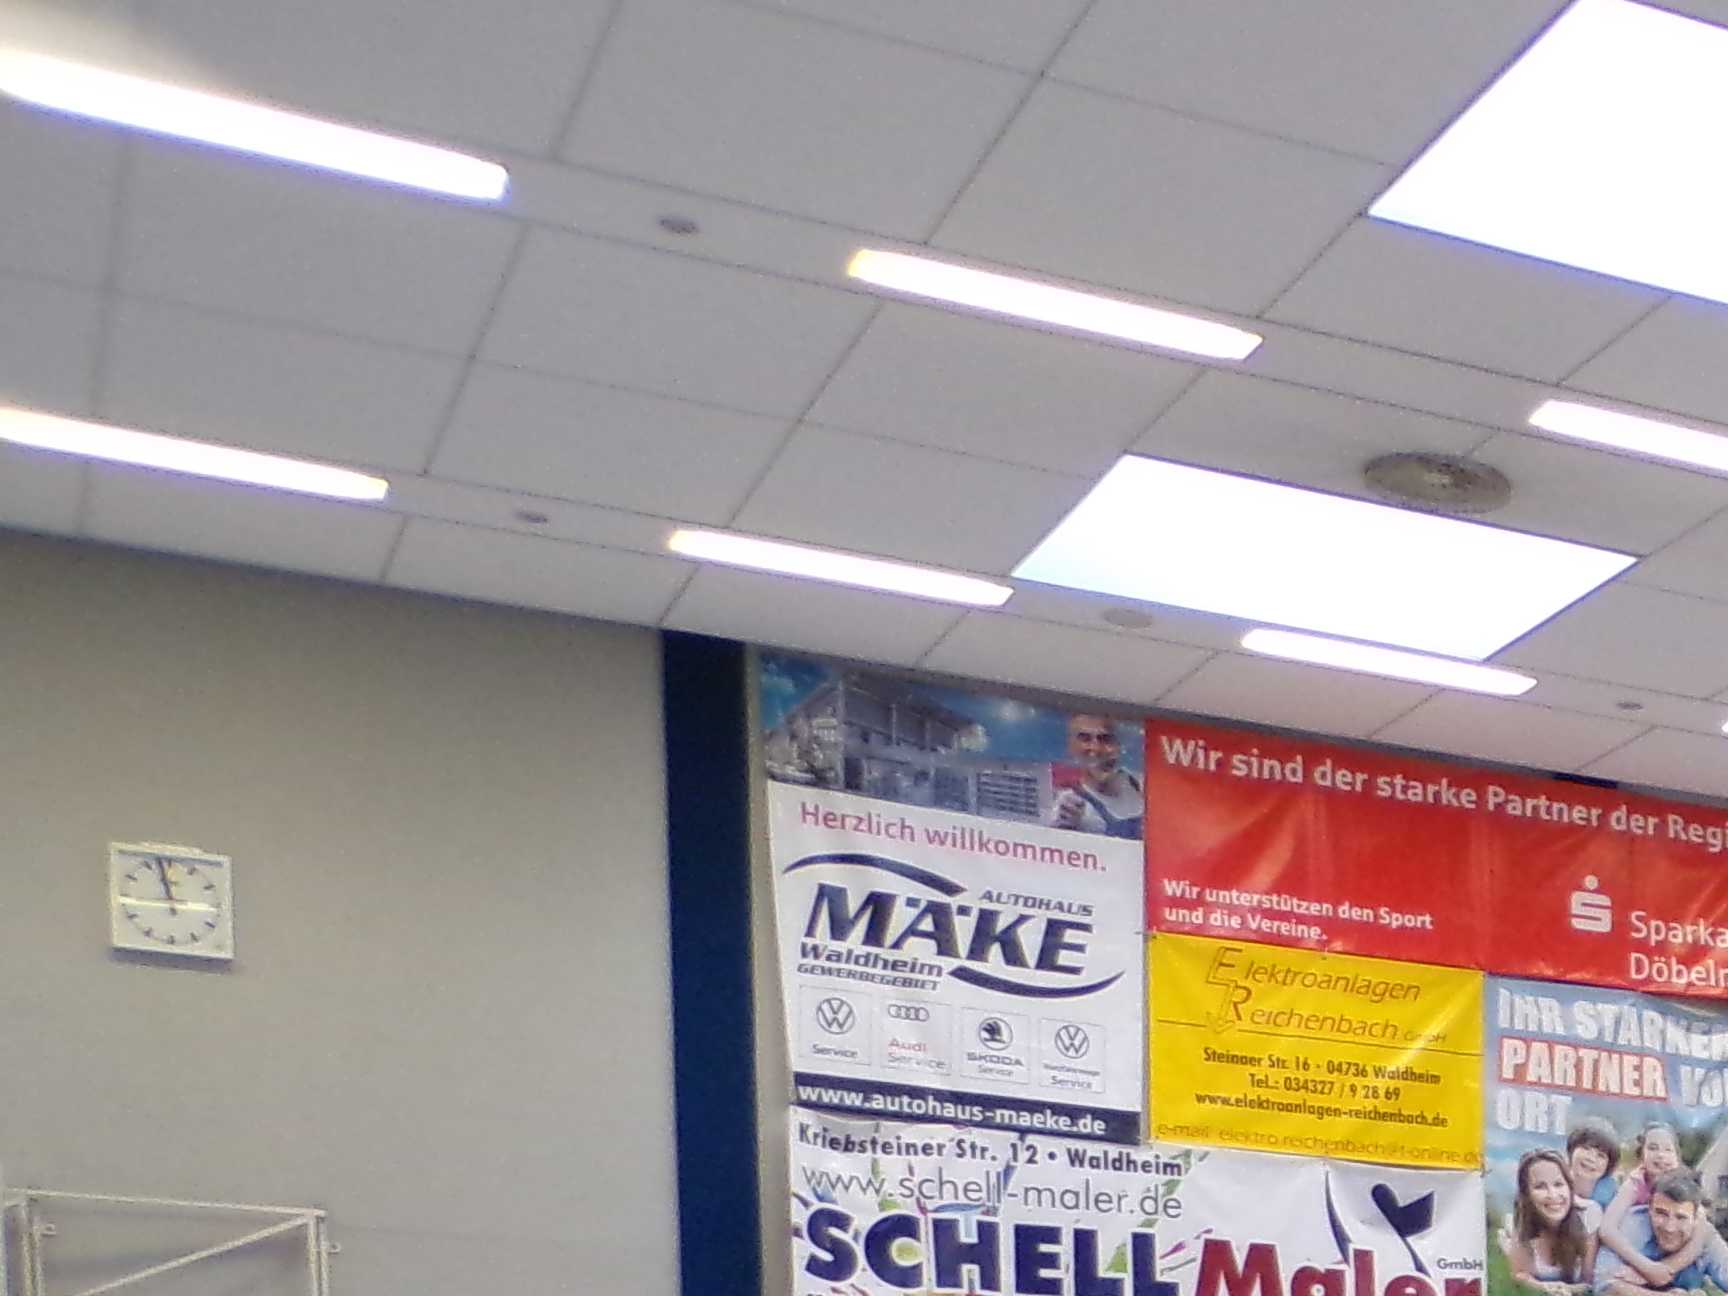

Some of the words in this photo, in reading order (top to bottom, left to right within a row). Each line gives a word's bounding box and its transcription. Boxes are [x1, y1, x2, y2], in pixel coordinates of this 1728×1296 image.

[1160, 735, 1224, 772] Wir
[1231, 747, 1304, 784] sind
[1313, 758, 1368, 793] der
[1376, 773, 1478, 809] starke
[1487, 785, 1602, 827] Partner
[1609, 803, 1660, 836] der
[800, 801, 916, 842] Herzlich
[924, 826, 1108, 872] willkommen.
[980, 888, 1094, 917] AUTOHAUS
[1163, 878, 1201, 900] Wir
[1205, 886, 1333, 918] unterstützen
[1338, 900, 1375, 923] den
[1378, 907, 1434, 930] Sport
[803, 882, 1093, 976] MÄKE
[1164, 906, 1204, 924] und
[1209, 908, 1242, 929] die
[1247, 913, 1328, 940] Vereine.
[797, 964, 941, 991] GEWERBEGEBIET
[800, 941, 944, 977] Waldheim
[1498, 987, 1568, 1036] IHR
[811, 1043, 859, 1059] Service
[886, 1052, 946, 1071] Service
[887, 1037, 928, 1053] Audi
[1050, 1074, 1094, 1091] Service
[1295, 1055, 1311, 1071] 16
[1326, 1058, 1369, 1078] 04736
[1373, 1064, 1442, 1085] Waldheim
[1500, 1037, 1668, 1098] PARTNER
[1283, 1076, 1335, 1095] 034327
[1362, 1085, 1381, 1099] 28
[1384, 1086, 1401, 1101] 69
[799, 1084, 1107, 1135] www.autohaus-maeke.de
[1195, 1091, 1449, 1129] www.elektroanlagen-reichenbach.de
[1496, 1088, 1573, 1136] ORT
[799, 1121, 948, 1158] Kriebsteiner
[955, 1139, 998, 1161] Str.
[1010, 1142, 1039, 1166] 12
[1066, 1146, 1184, 1178] Waldheim
[802, 1167, 1183, 1220] www.schell-maler.de
[1436, 1257, 1484, 1272] GmbH
